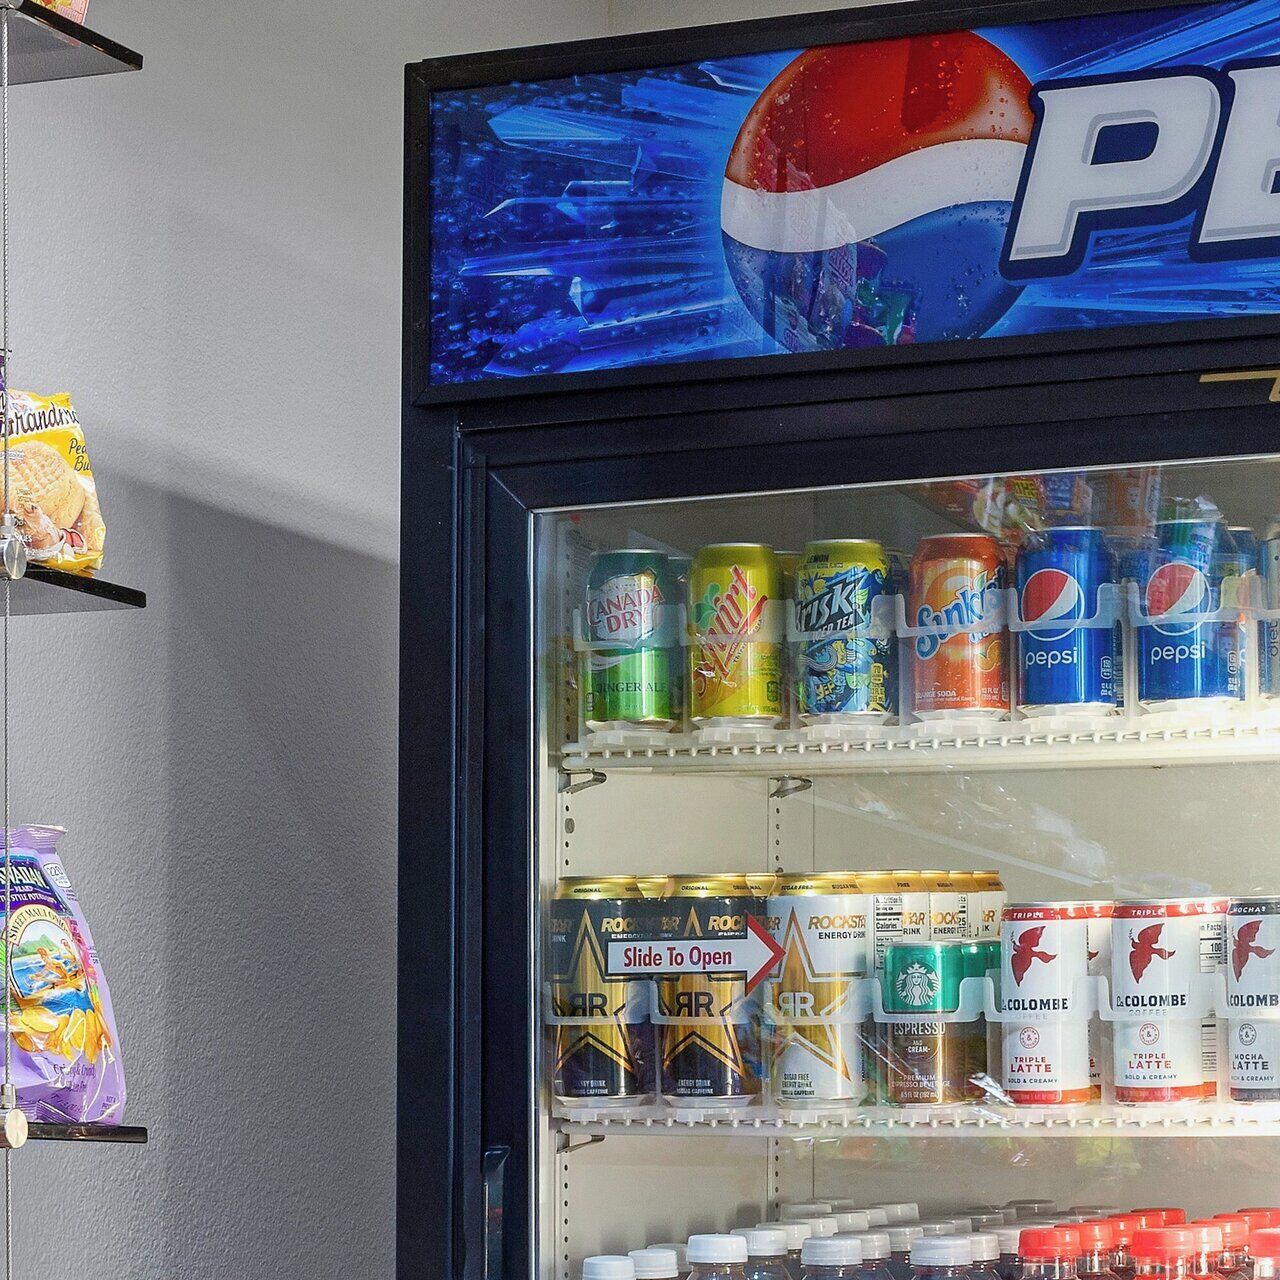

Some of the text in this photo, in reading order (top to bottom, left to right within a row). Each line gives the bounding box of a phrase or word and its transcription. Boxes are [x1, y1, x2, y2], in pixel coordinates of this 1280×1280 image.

[606, 608, 649, 634] DRY
[1026, 647, 1078, 668] pepsi
[1151, 642, 1206, 666] pepsi
[623, 948, 732, 970] Slide To Open
[1007, 998, 1069, 1011] COLOMBE
[1125, 994, 1187, 1007] COLOMBE
[1014, 1056, 1047, 1064] TRIPLE
[1133, 1052, 1167, 1060] TRIPLE
[1010, 1064, 1052, 1073] LATTE
[1128, 1060, 1172, 1070] LATTE
[1232, 1061, 1269, 1071] LATTE
